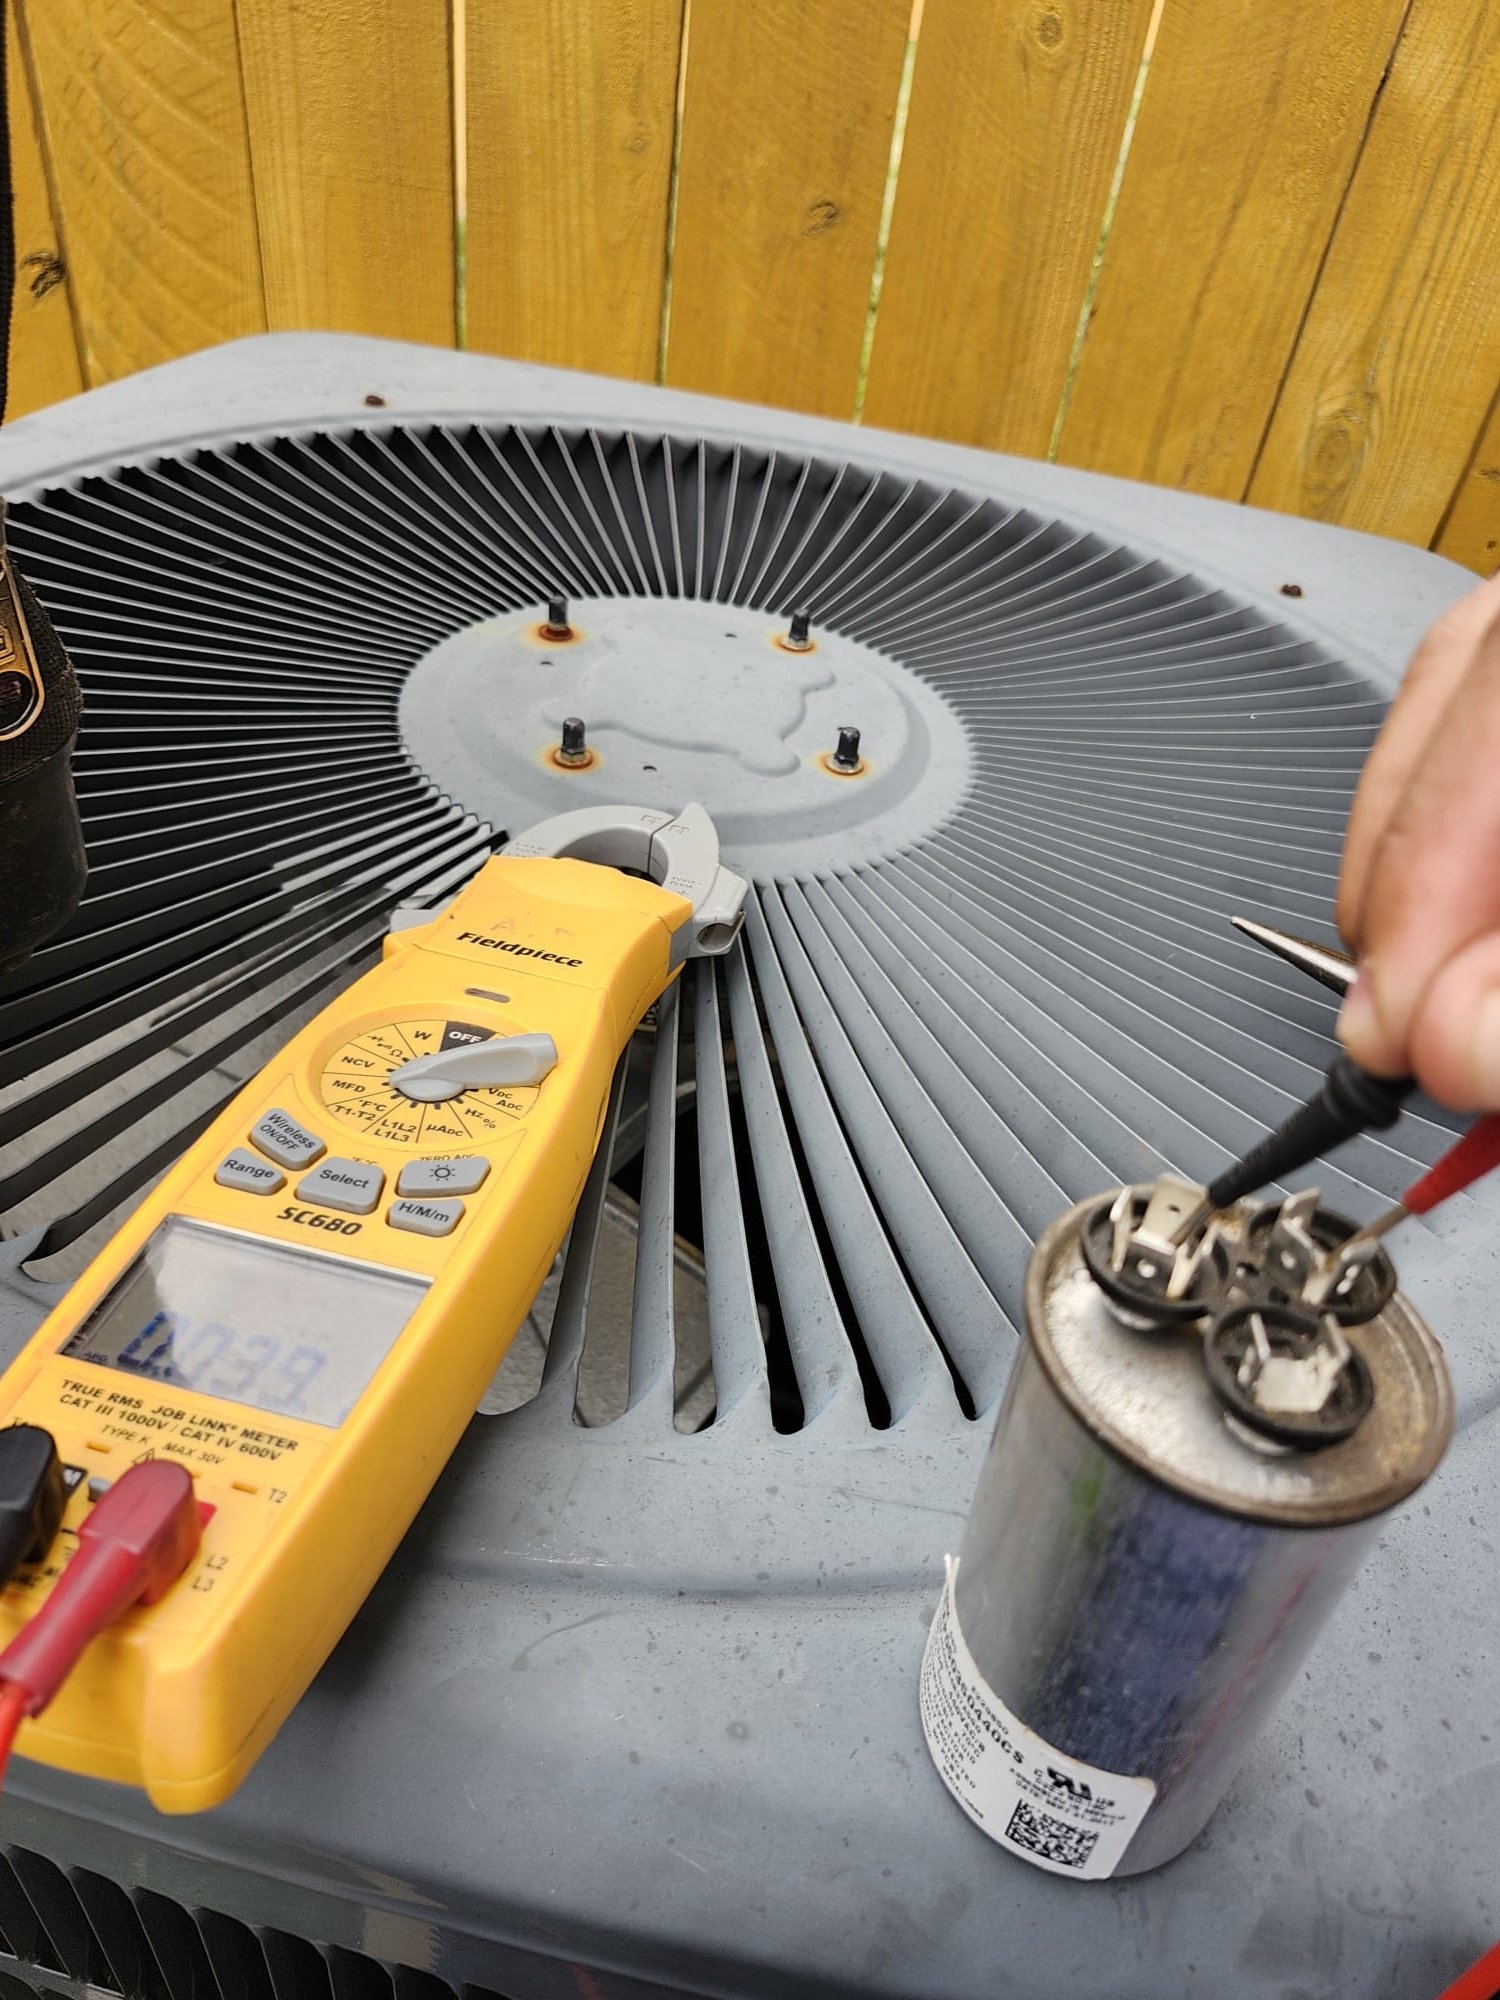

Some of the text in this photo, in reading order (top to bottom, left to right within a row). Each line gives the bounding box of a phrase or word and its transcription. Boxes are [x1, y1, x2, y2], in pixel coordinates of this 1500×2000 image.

[456, 931, 583, 968] Fieldpiece
[414, 1030, 433, 1041] W
[448, 1031, 482, 1043] OFF
[341, 1055, 376, 1069] NCV
[332, 1079, 366, 1093] MFD
[334, 1105, 377, 1121] T1-T2
[267, 1113, 316, 1149] Wireless
[381, 1119, 418, 1133] L1L2
[260, 1124, 300, 1151] ON/OFF
[374, 1129, 410, 1143] L1L3
[224, 1159, 275, 1179] Range
[319, 1169, 370, 1189] Select
[276, 1207, 363, 1235] SC680
[398, 1201, 450, 1223] H/M/m
[62, 1379, 105, 1398] TRUE
[108, 1392, 144, 1409] RMS
[151, 1405, 186, 1421] JOB
[240, 1428, 299, 1451] METER
[60, 1393, 91, 1409] CAT
[95, 1404, 113, 1416] III
[118, 1410, 169, 1431] 1000V
[180, 1427, 214, 1443] CAT
[217, 1437, 237, 1449] IV
[239, 1443, 282, 1462] 600V
[100, 1424, 229, 1465] TYPE K MAX 30V
[268, 1488, 287, 1503] T2
[205, 1553, 229, 1570] L2
[192, 1576, 215, 1592] L3
